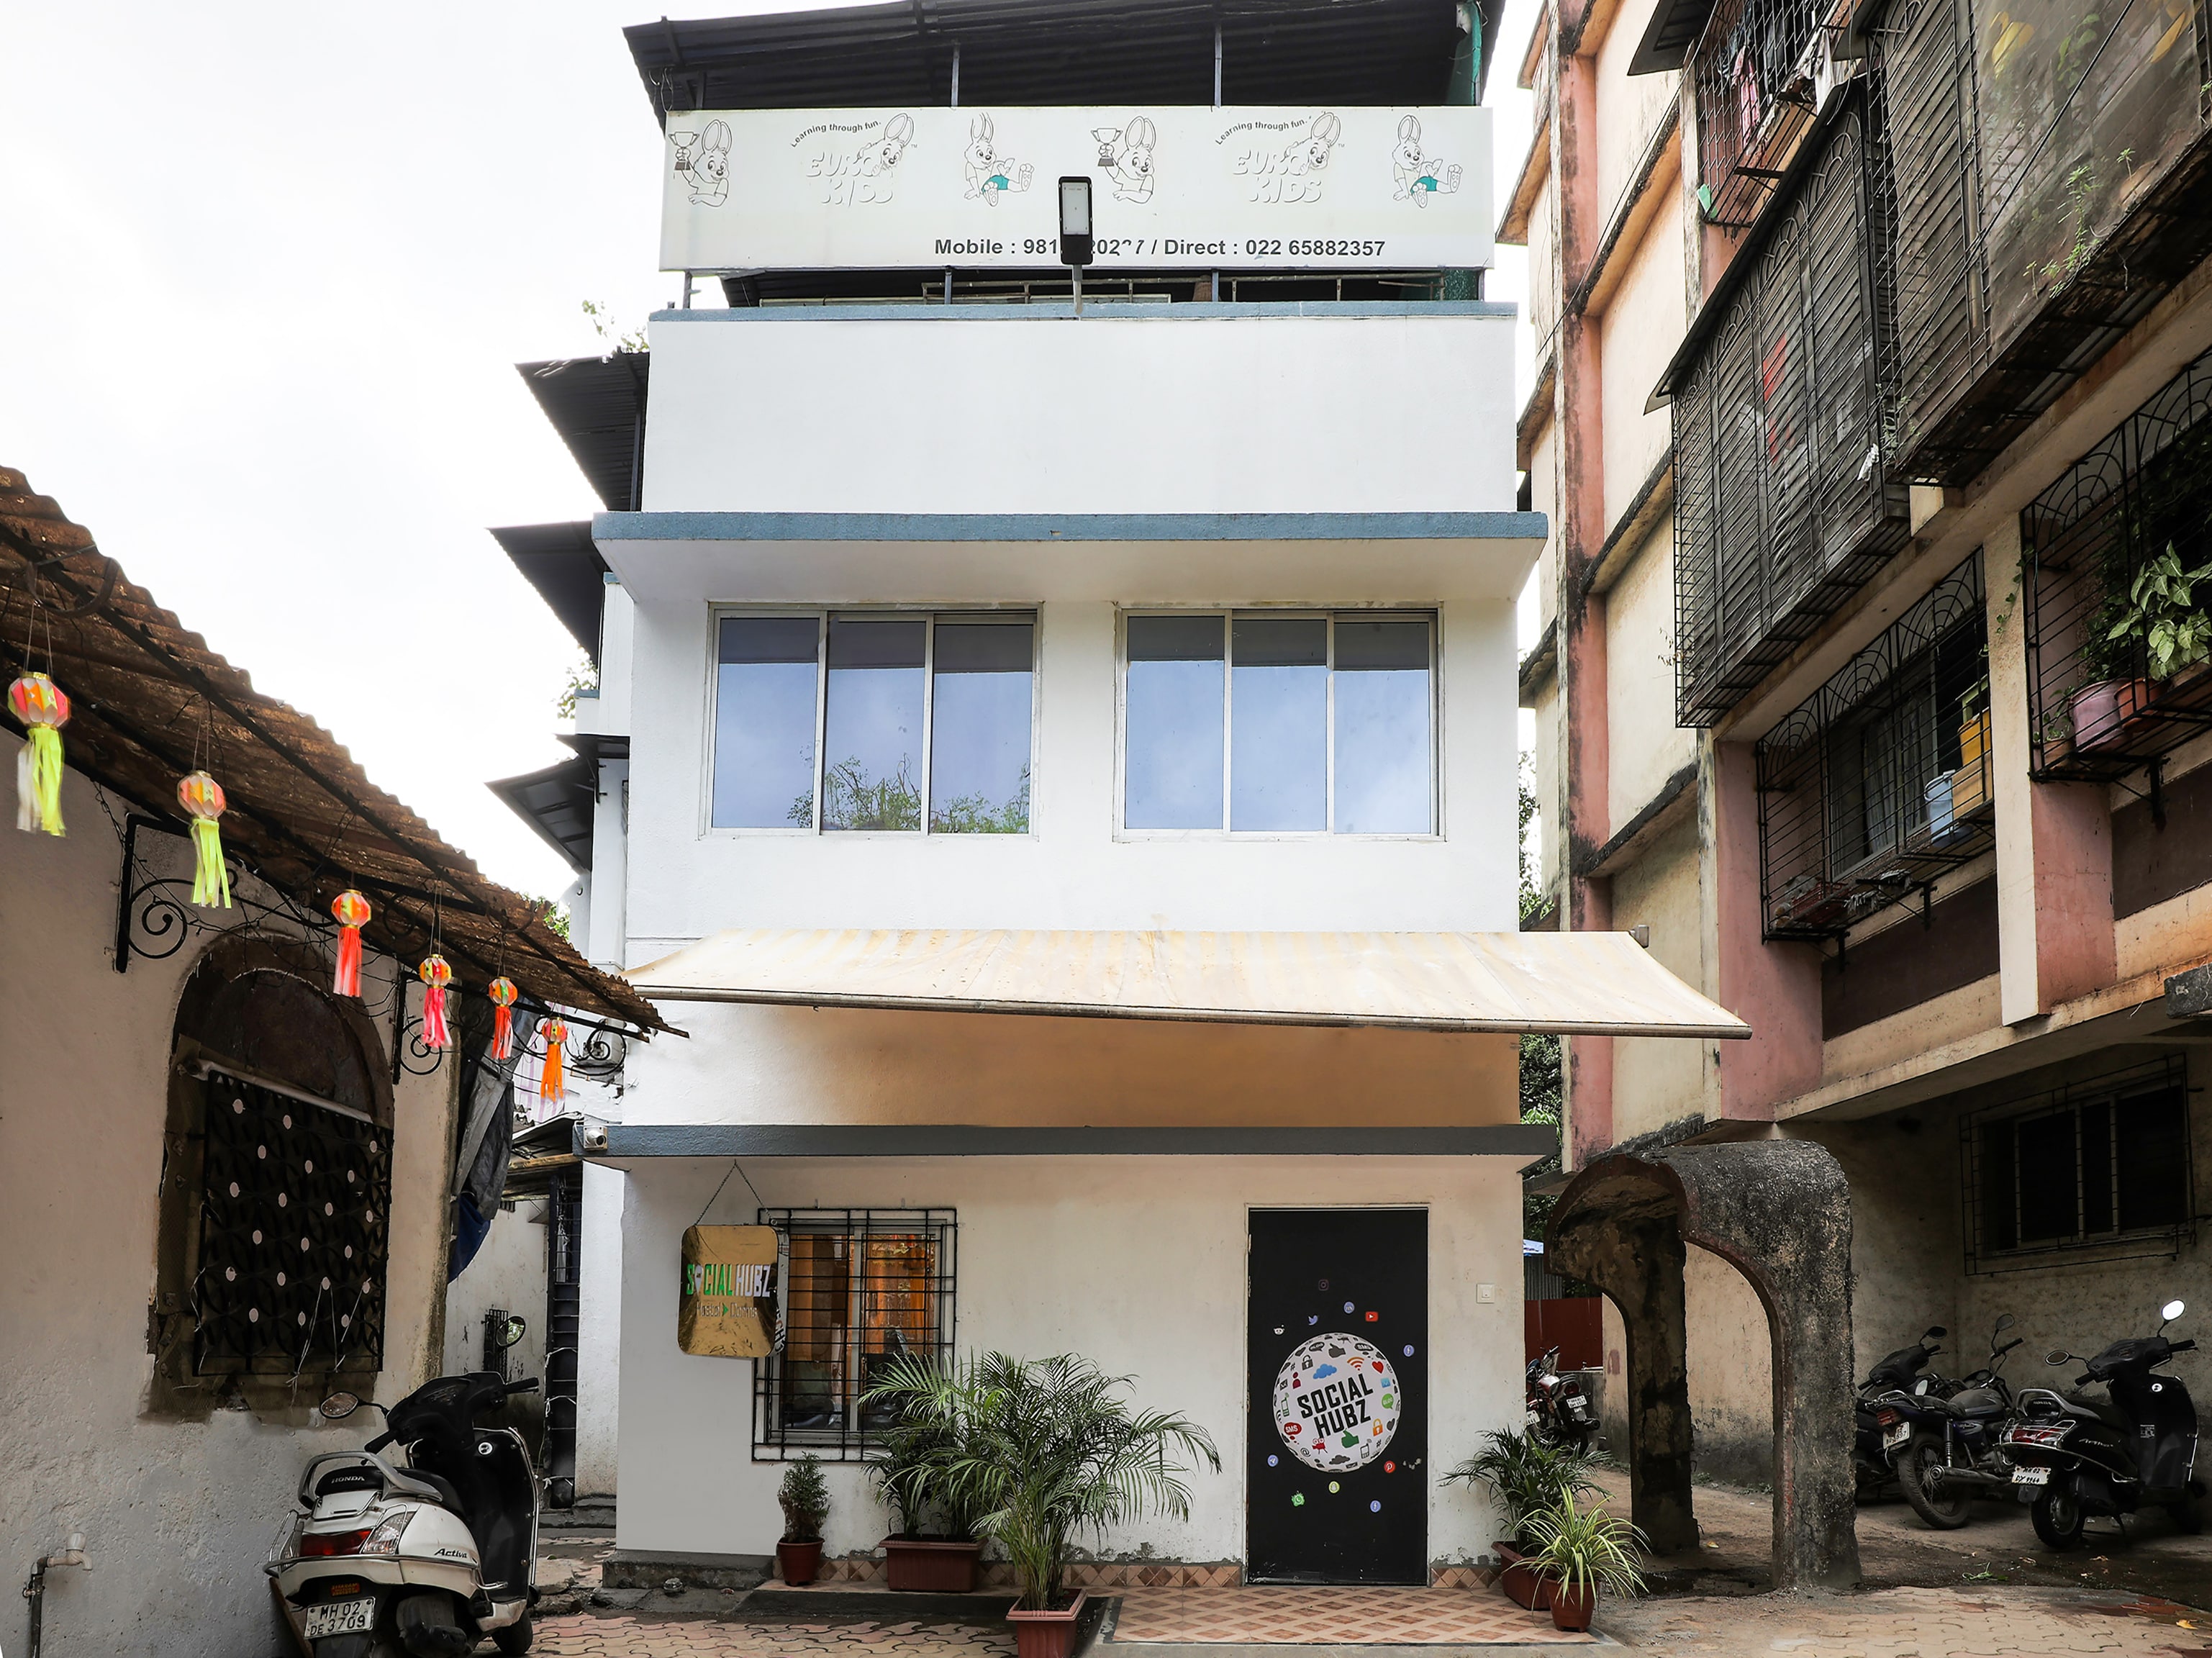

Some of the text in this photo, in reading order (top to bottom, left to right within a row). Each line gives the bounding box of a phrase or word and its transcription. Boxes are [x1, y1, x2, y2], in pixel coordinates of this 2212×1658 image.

[792, 124, 827, 148] Learning
[829, 123, 863, 133] through
[1215, 122, 1253, 145] Learning
[1255, 121, 1289, 132] through
[935, 239, 1003, 254] Mobile
[1164, 240, 1226, 255] Direct
[1246, 240, 1282, 255] 022
[1289, 240, 1386, 256] 65882357
[1297, 1373, 1374, 1419] SOCIAL
[1285, 1425, 1298, 1433] SMS
[1313, 1398, 1372, 1439] HUBZ
[434, 1548, 467, 1558] Activa
[320, 1602, 361, 1619] MH 02
[310, 1615, 365, 1636] DE 3709
